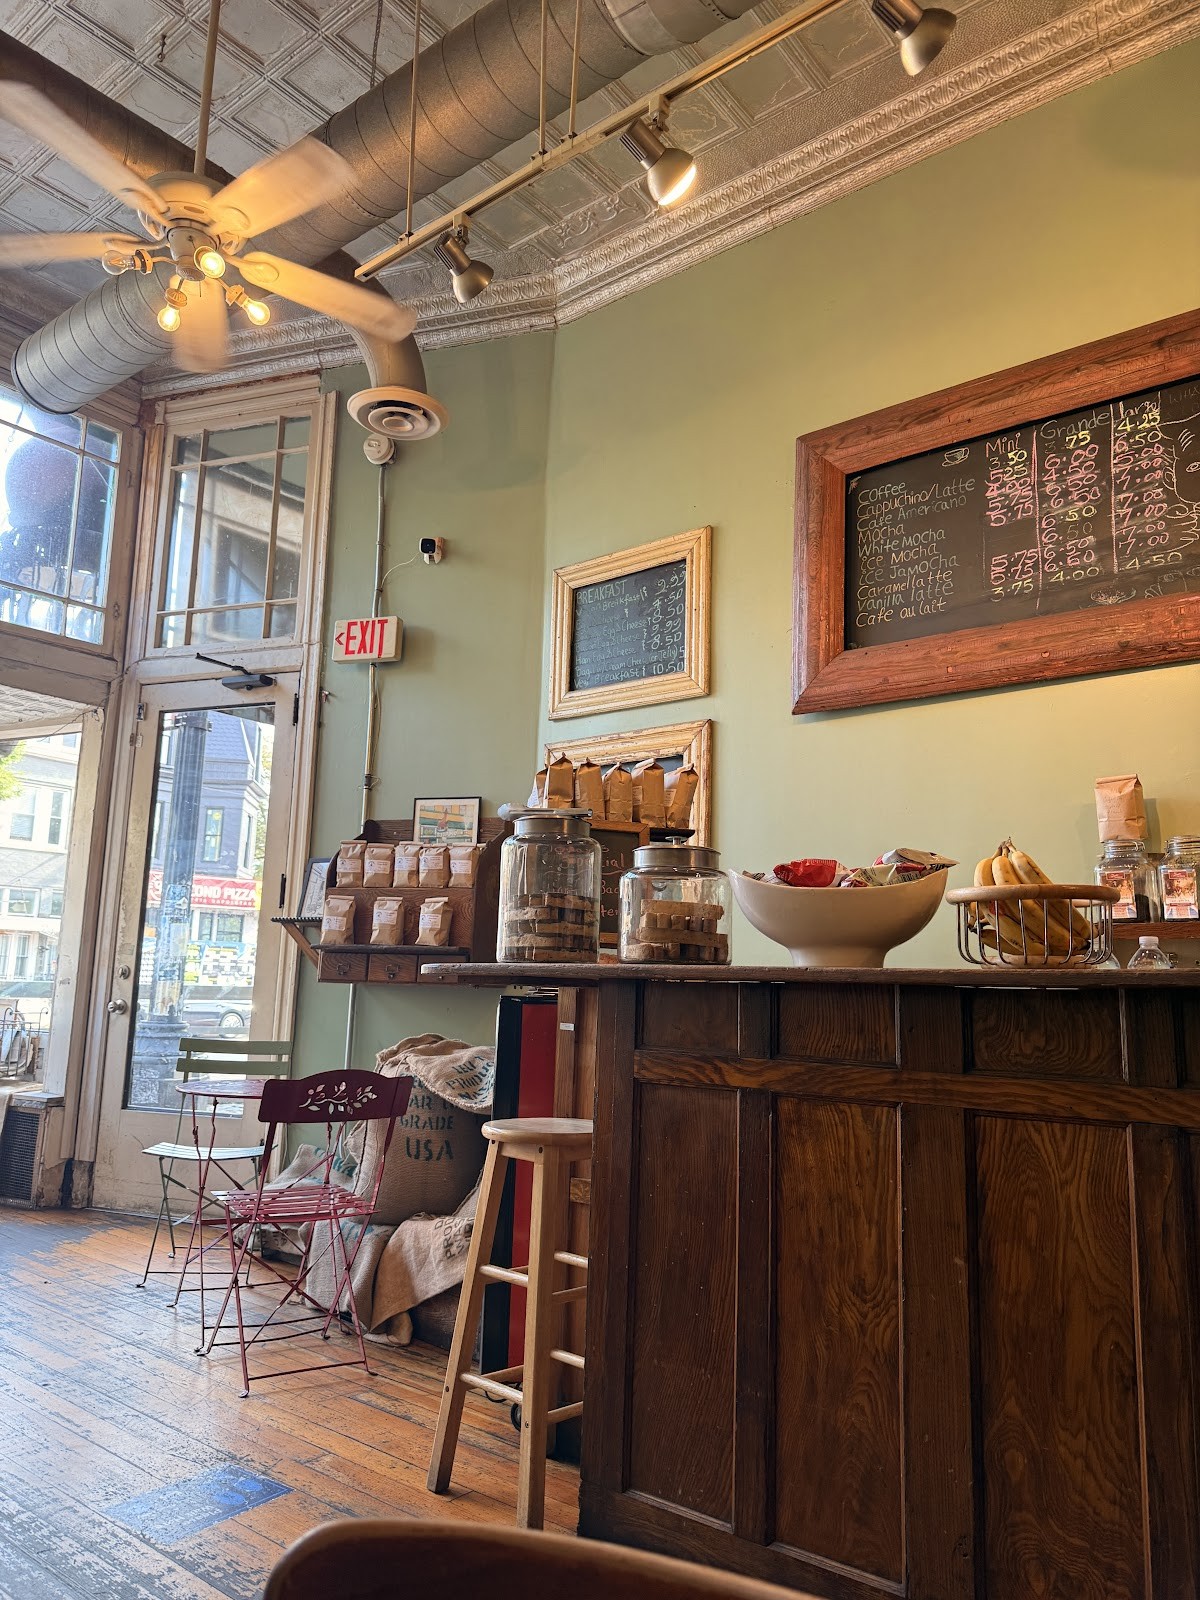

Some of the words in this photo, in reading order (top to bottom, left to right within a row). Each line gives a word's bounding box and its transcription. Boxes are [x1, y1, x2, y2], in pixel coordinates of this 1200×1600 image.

[985, 432, 1021, 457] Mini
[1040, 410, 1110, 438] Grande
[858, 482, 906, 504] Coffee
[1117, 412, 1161, 432] 4.25
[1044, 444, 1099, 469] 6.00
[857, 514, 892, 532] Cafe
[898, 495, 967, 520] Americano
[1042, 461, 1096, 482] 4.50
[858, 540, 900, 558] White
[577, 579, 628, 604] BREAKFAST
[856, 607, 894, 627] Cafe
[899, 606, 916, 619] au
[919, 597, 947, 615] lait
[990, 579, 1034, 602] 3.75
[1050, 567, 1099, 583] 4.00
[1126, 552, 1182, 570] 4.50
[857, 576, 909, 600] Caramel
[912, 570, 953, 589] latte
[911, 581, 954, 602] latte
[345, 619, 388, 658] EXIT
[594, 668, 640, 685] Breakfast
[223, 887, 257, 900] PIZZA
[399, 1114, 455, 1131] GRADE
[405, 1136, 454, 1162] USA
